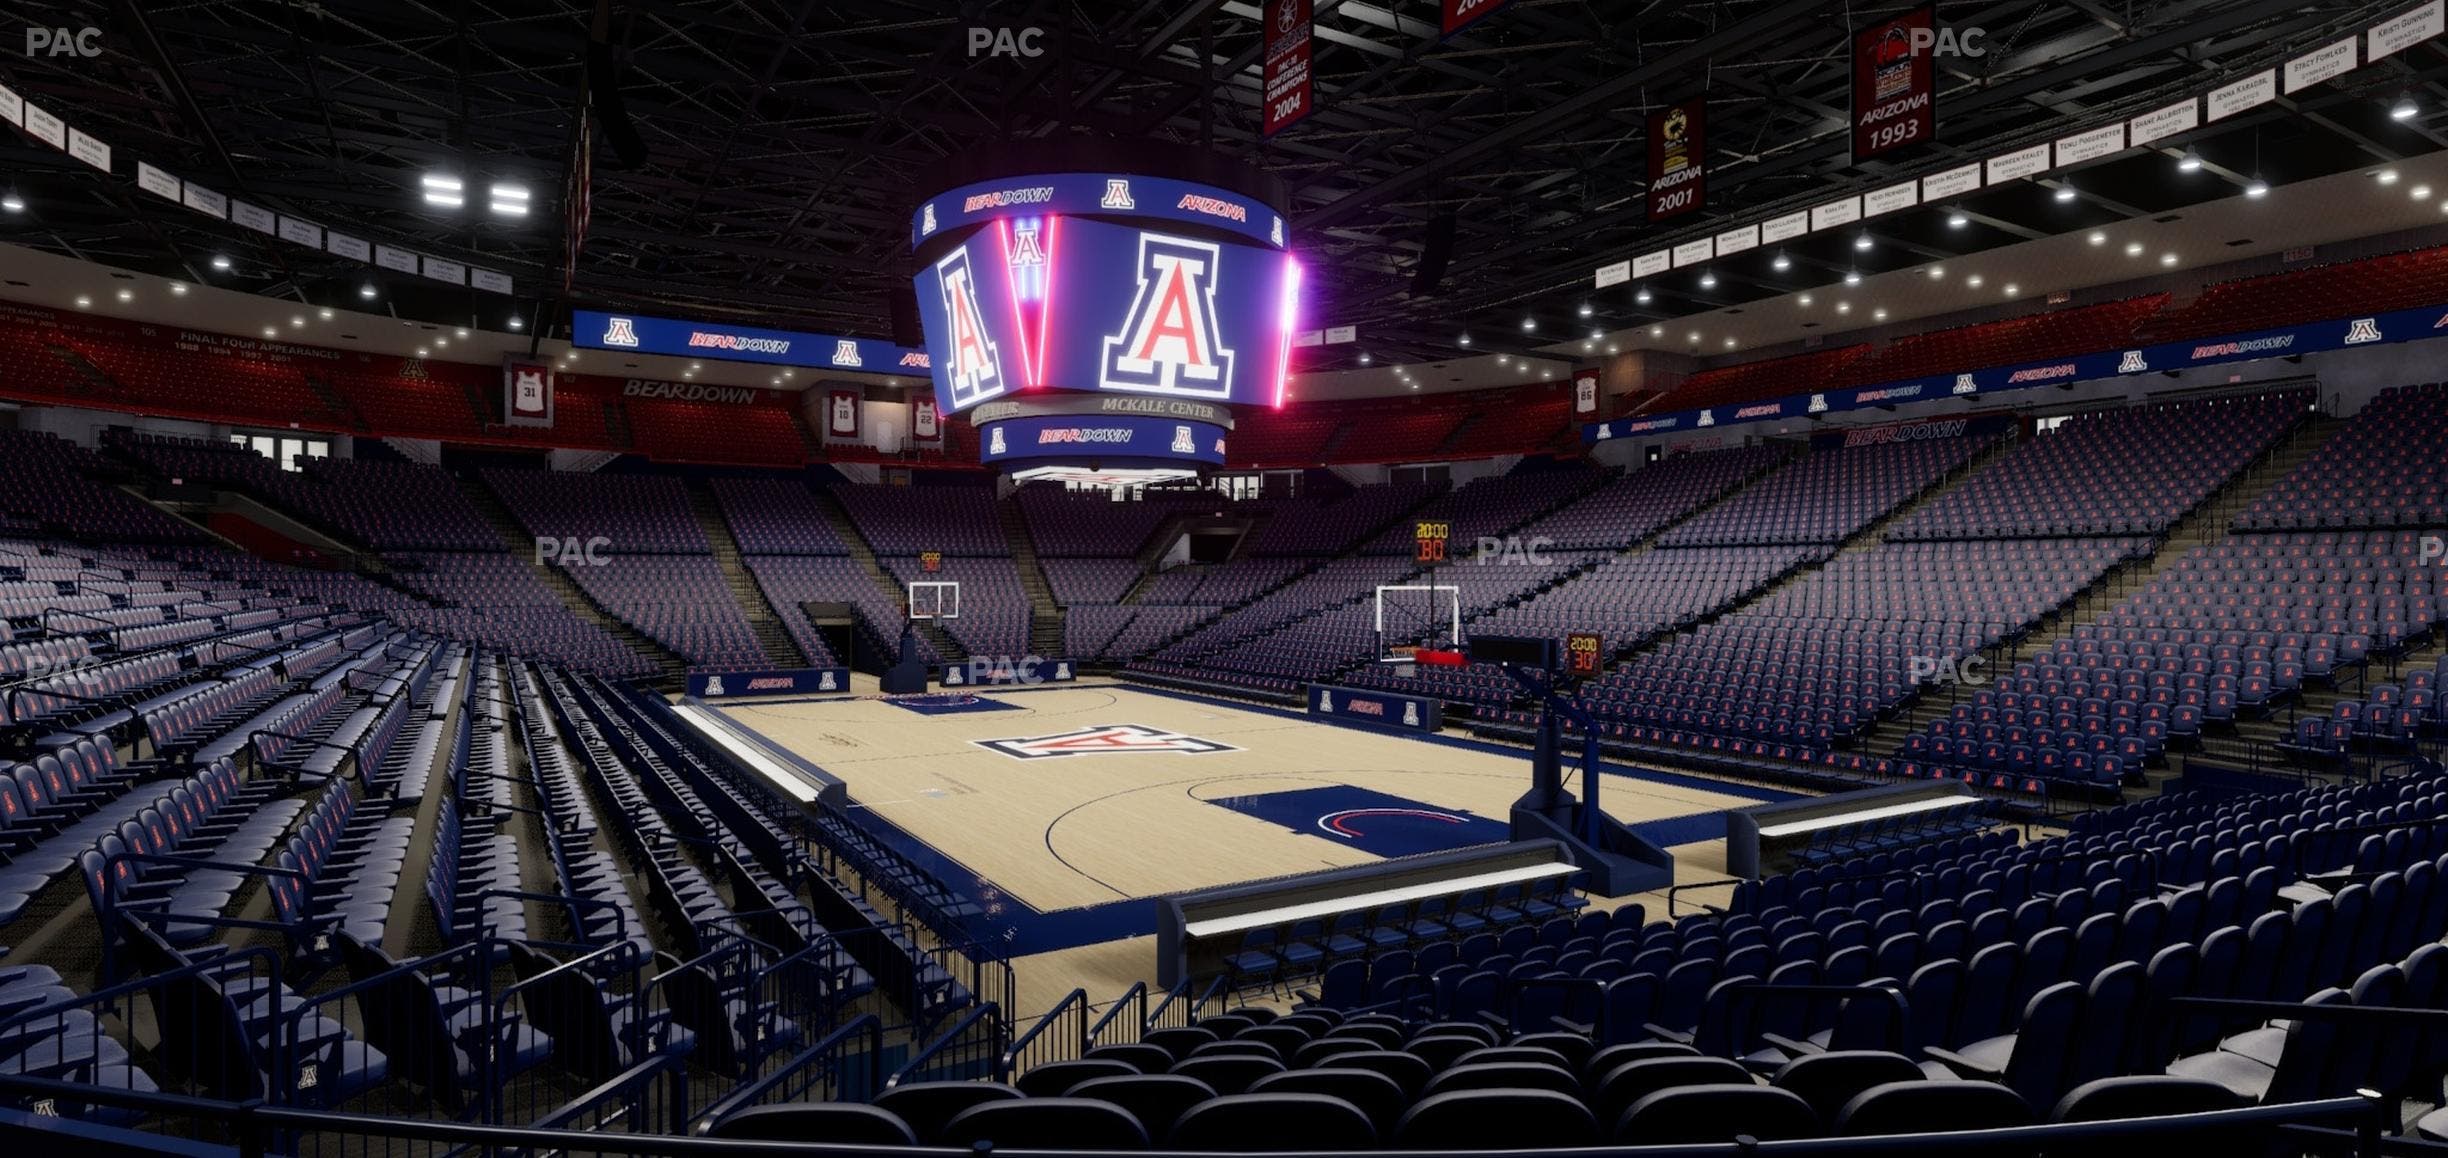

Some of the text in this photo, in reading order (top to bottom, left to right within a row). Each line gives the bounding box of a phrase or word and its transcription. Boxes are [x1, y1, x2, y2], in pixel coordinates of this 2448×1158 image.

[1266, 59, 1309, 91] CONFERENCE
[1266, 70, 1308, 103] CHAMPIONS
[1272, 91, 1302, 123] 2004
[1859, 92, 1929, 127] ARIZONA
[1869, 118, 1920, 150] 1993
[1650, 165, 1703, 193] ARIZONA
[922, 203, 937, 236] A
[963, 187, 1054, 213] BEARDOWN
[1101, 179, 1135, 210] A
[1177, 194, 1247, 223] ARIZONA
[1656, 188, 1694, 214] 2001
[936, 245, 1005, 410] A
[1100, 231, 1235, 399] A
[180, 331, 341, 361] FINAL FOUR APPEARANCES
[603, 317, 931, 368] A BEARDOWN A ARI
[1808, 393, 1828, 413] A
[1952, 372, 1977, 395] A
[2008, 363, 2075, 384] ARIZONA
[2118, 350, 2148, 374] A
[2345, 318, 2382, 345] A
[524, 387, 536, 398] 31
[920, 414, 932, 425] 22
[1102, 398, 1214, 420] MCKALE CENTER
[990, 427, 1006, 455] A
[1038, 428, 1133, 444] BEARDOWN
[1172, 426, 1195, 455] A
[1570, 637, 1597, 651] 20:00
[705, 671, 837, 696] A ARIZONA A
[1402, 702, 1420, 727] A
